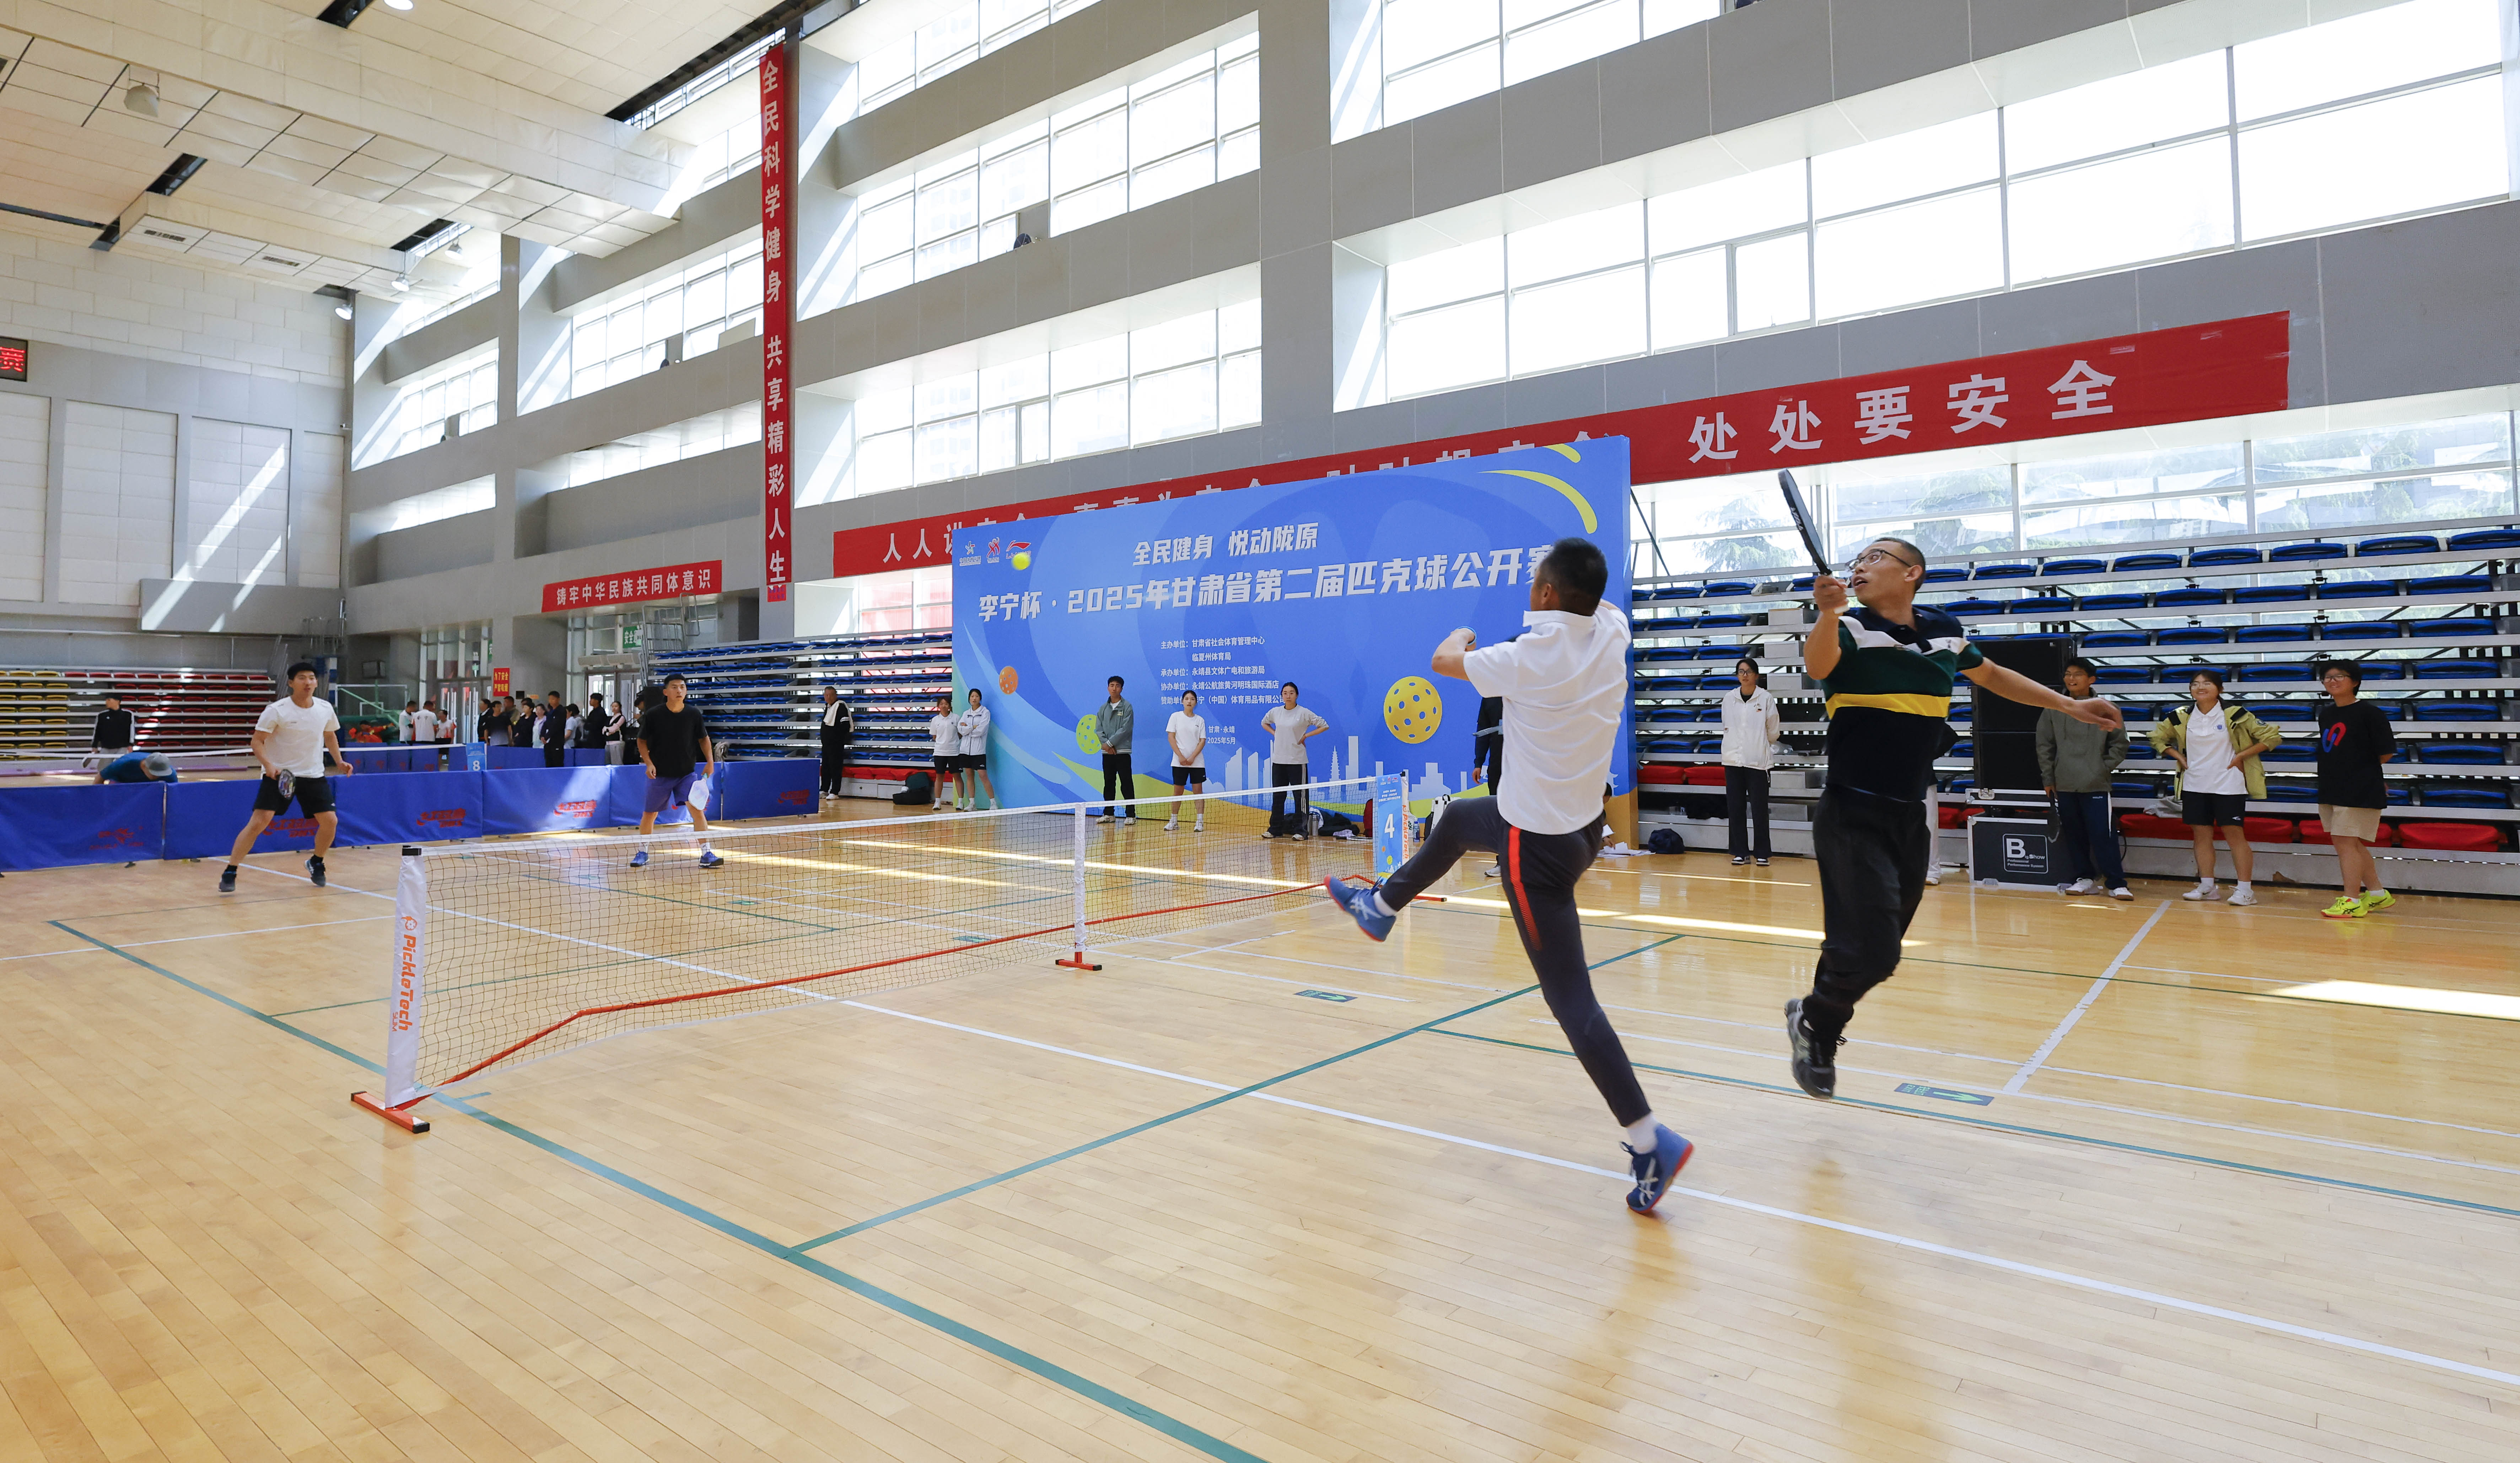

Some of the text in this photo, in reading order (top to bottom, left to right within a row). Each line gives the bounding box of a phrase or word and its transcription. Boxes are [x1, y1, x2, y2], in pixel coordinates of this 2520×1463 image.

[763, 60, 781, 303] 全民科学健身
[1688, 360, 2116, 464] 处处要安全
[766, 335, 786, 582] 共享精彩人生
[1132, 522, 1319, 566] 全民健身 悦动陇原
[557, 569, 710, 606] 铸牢中华民族共同体意识
[1192, 652, 1231, 662] 临夏州体育局
[1207, 737, 1235, 745] 2025年5月
[473, 760, 480, 771] 8
[1384, 813, 1395, 838] 4
[398, 934, 416, 1031] PickleTech
